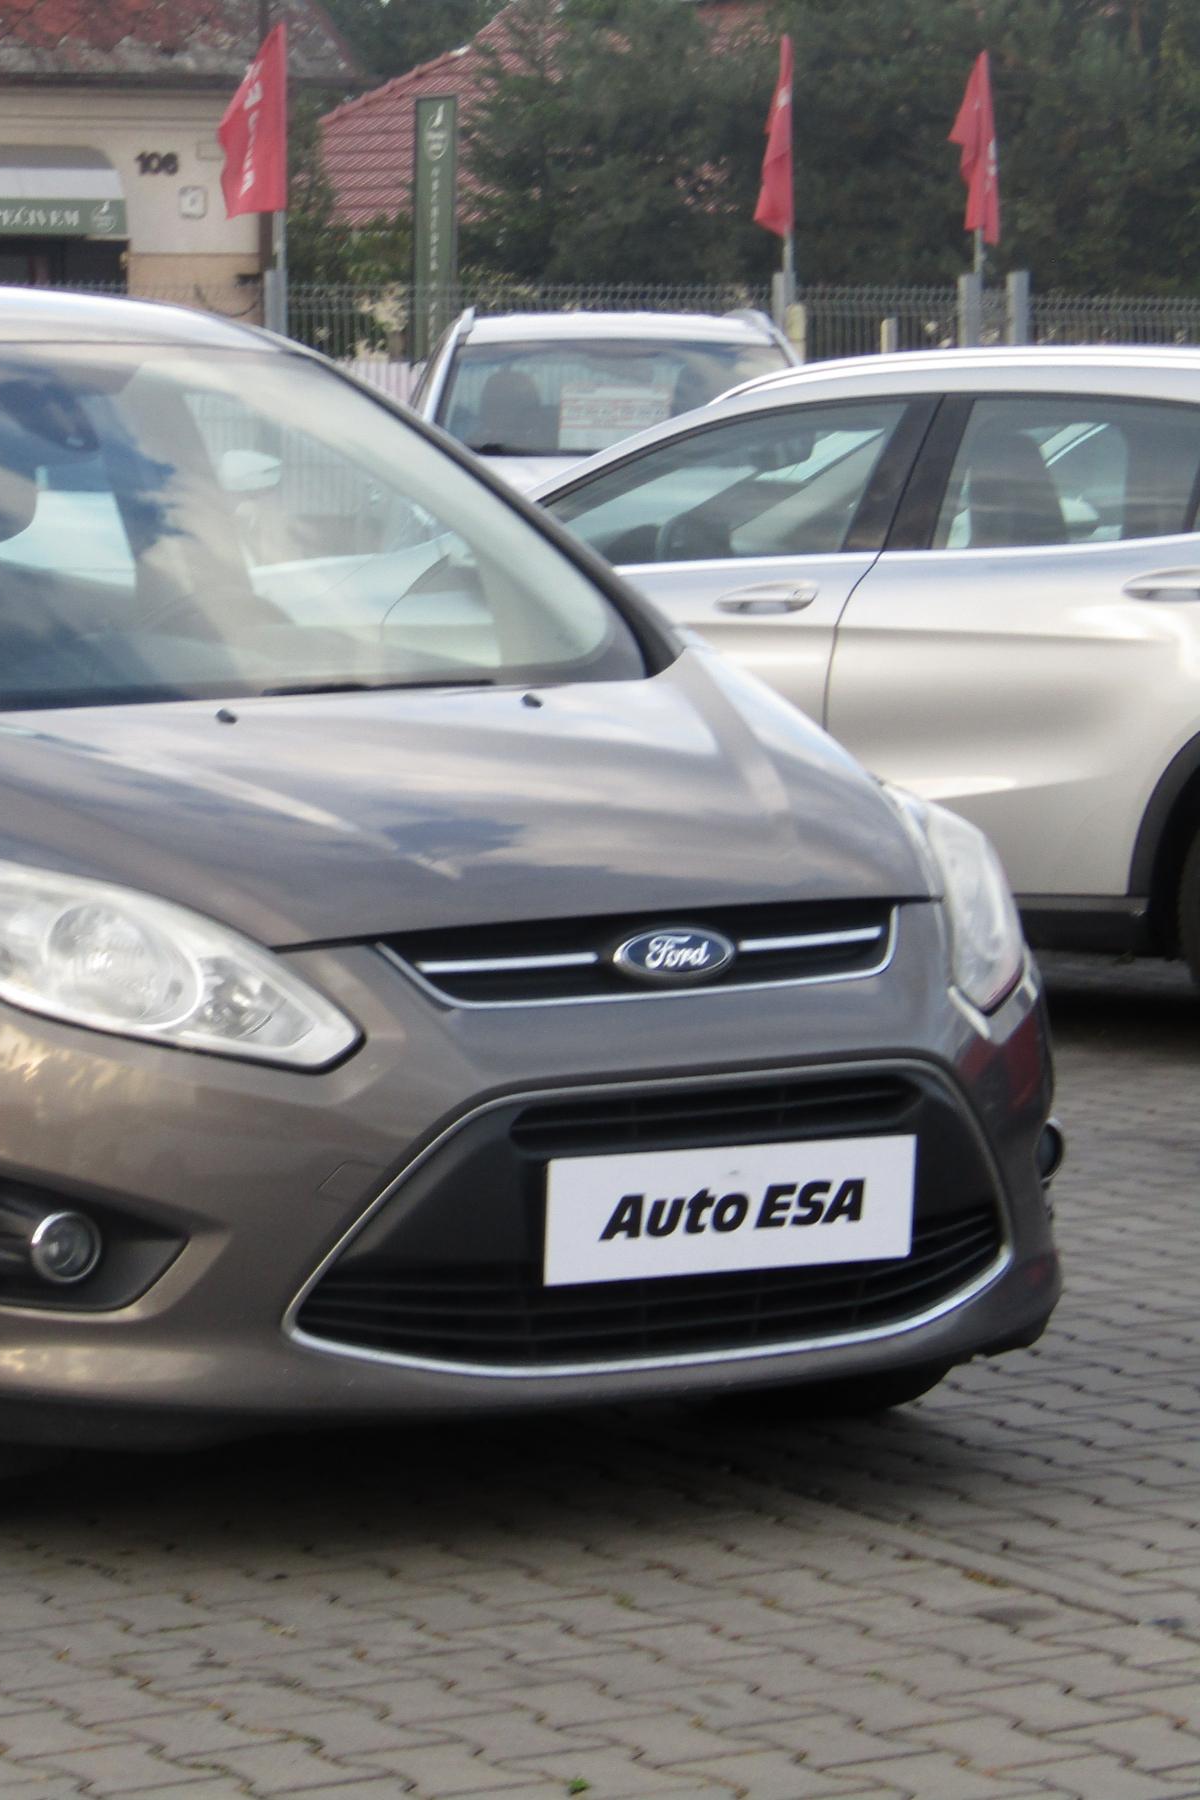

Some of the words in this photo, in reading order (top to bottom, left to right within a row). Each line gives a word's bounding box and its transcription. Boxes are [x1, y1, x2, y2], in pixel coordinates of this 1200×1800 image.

[135, 152, 179, 175] 106
[644, 934, 711, 968] Ford
[599, 1187, 749, 1242] Auto
[754, 1177, 867, 1230] ESA
